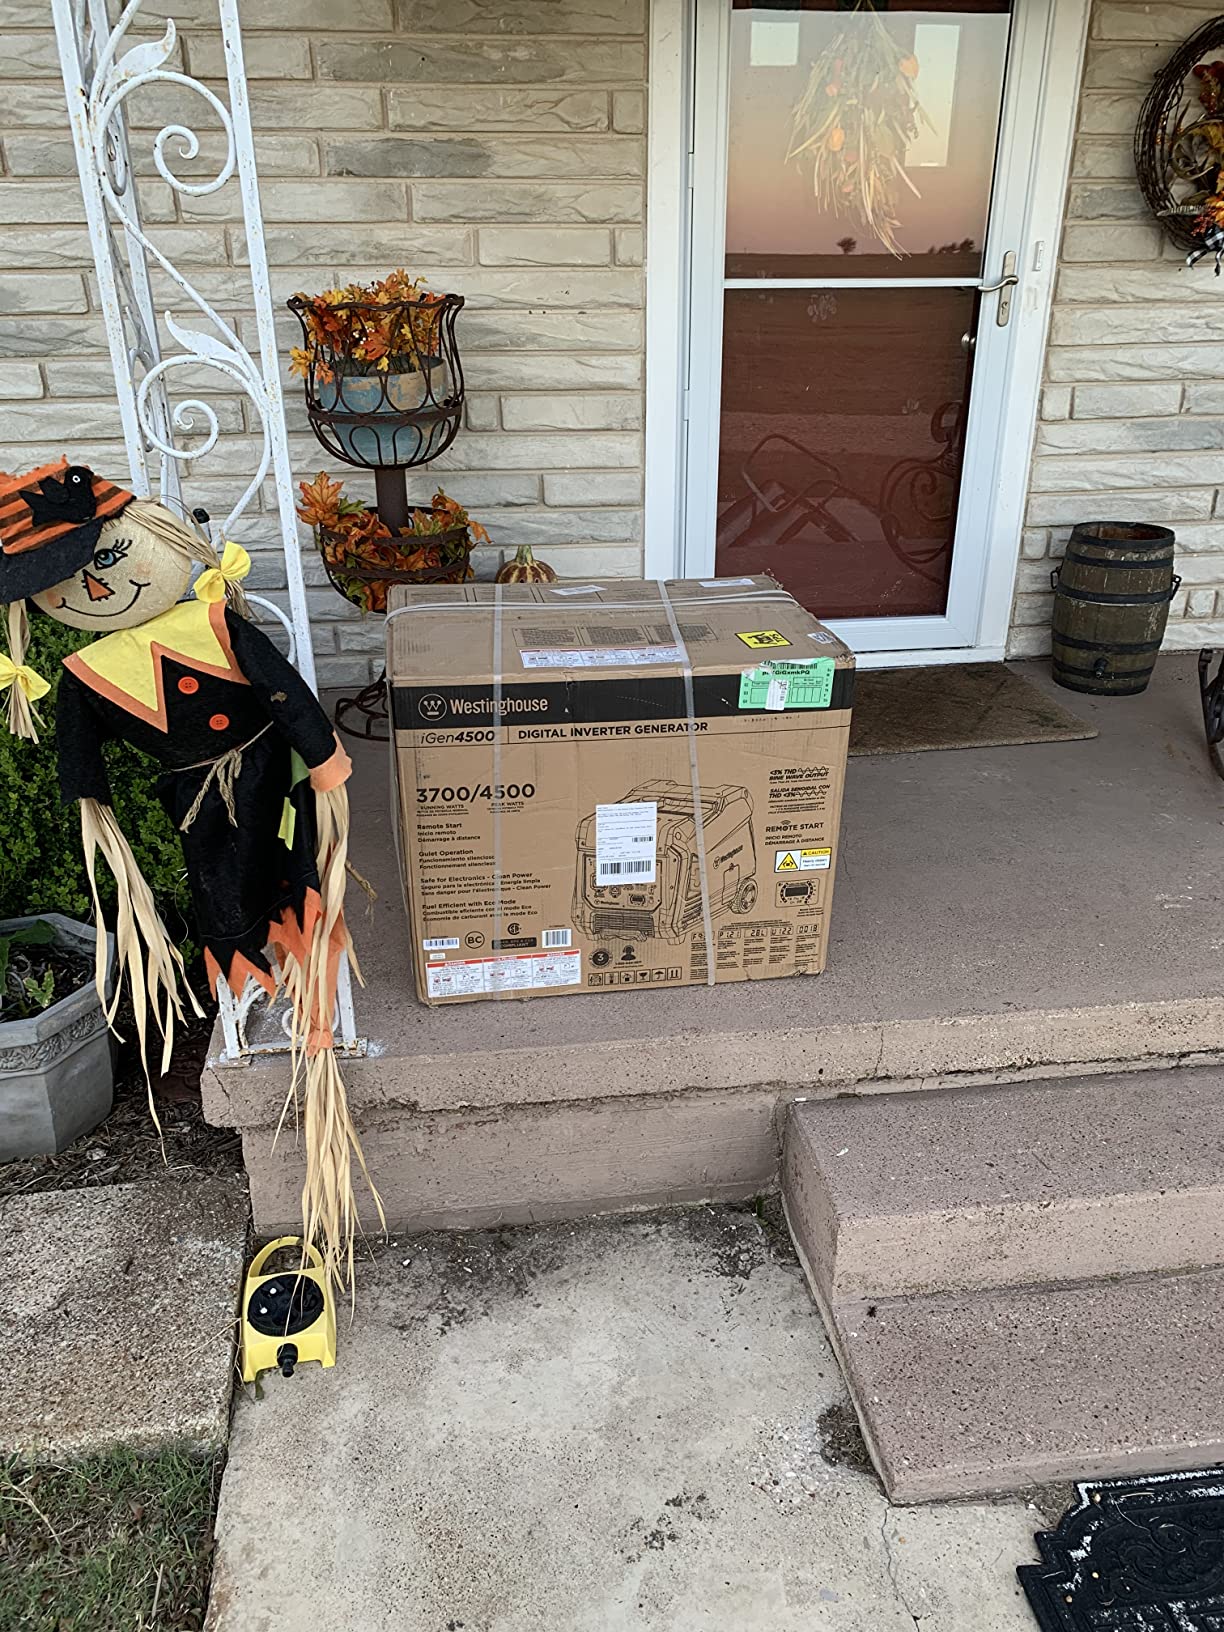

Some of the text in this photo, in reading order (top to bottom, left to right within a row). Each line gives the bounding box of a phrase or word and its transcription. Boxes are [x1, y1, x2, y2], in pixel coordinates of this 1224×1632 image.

[450, 697, 549, 716] Westinghouse
[420, 730, 495, 744] iGen4500
[518, 722, 708, 739] DIGITAL INVERTER GENERATOR
[416, 783, 535, 803] 3700/4500
[800, 822, 824, 830] START
[448, 874, 486, 882] Electronics
[467, 935, 482, 944] BC
